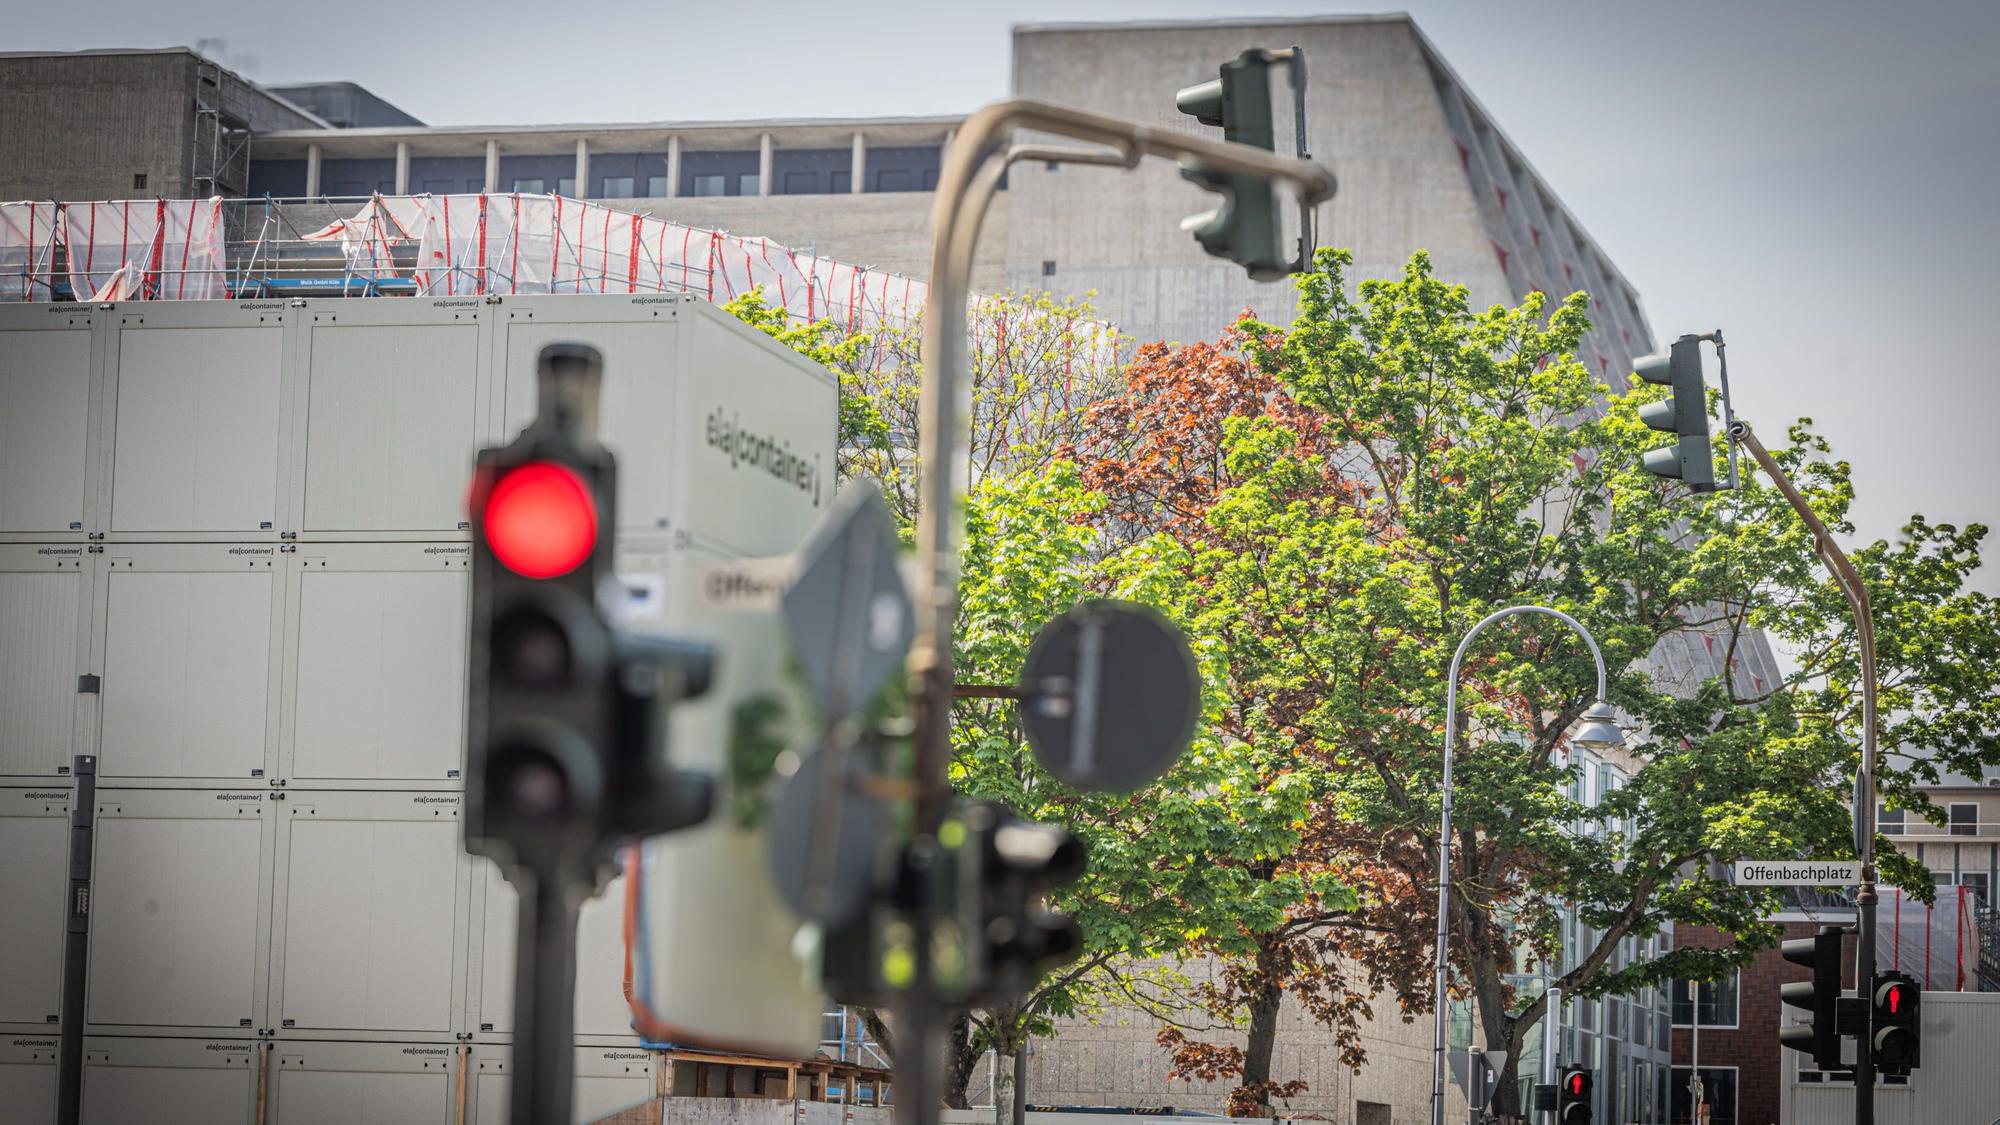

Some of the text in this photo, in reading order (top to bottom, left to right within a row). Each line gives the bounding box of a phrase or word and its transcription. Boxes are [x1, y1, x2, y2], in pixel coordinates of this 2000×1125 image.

[433, 300, 479, 309] ela[container]
[632, 297, 678, 305] ela[container]
[49, 305, 93, 314] ela[container]
[240, 302, 285, 311] ela[container]
[705, 406, 821, 507] ela[container]
[38, 547, 83, 556] ela[container]
[229, 547, 274, 556] ela[container]
[424, 546, 470, 555] ela[container]
[24, 791, 69, 801] ela[container]
[216, 793, 262, 802] ela[container]
[414, 796, 460, 805] ela[container]
[1743, 866, 1852, 882] Offenbachplatz
[13, 1038, 58, 1048] ela[container]
[206, 1042, 252, 1052] ela[container]
[402, 1047, 449, 1057] ela[container]
[603, 1051, 650, 1061] ela[container]
